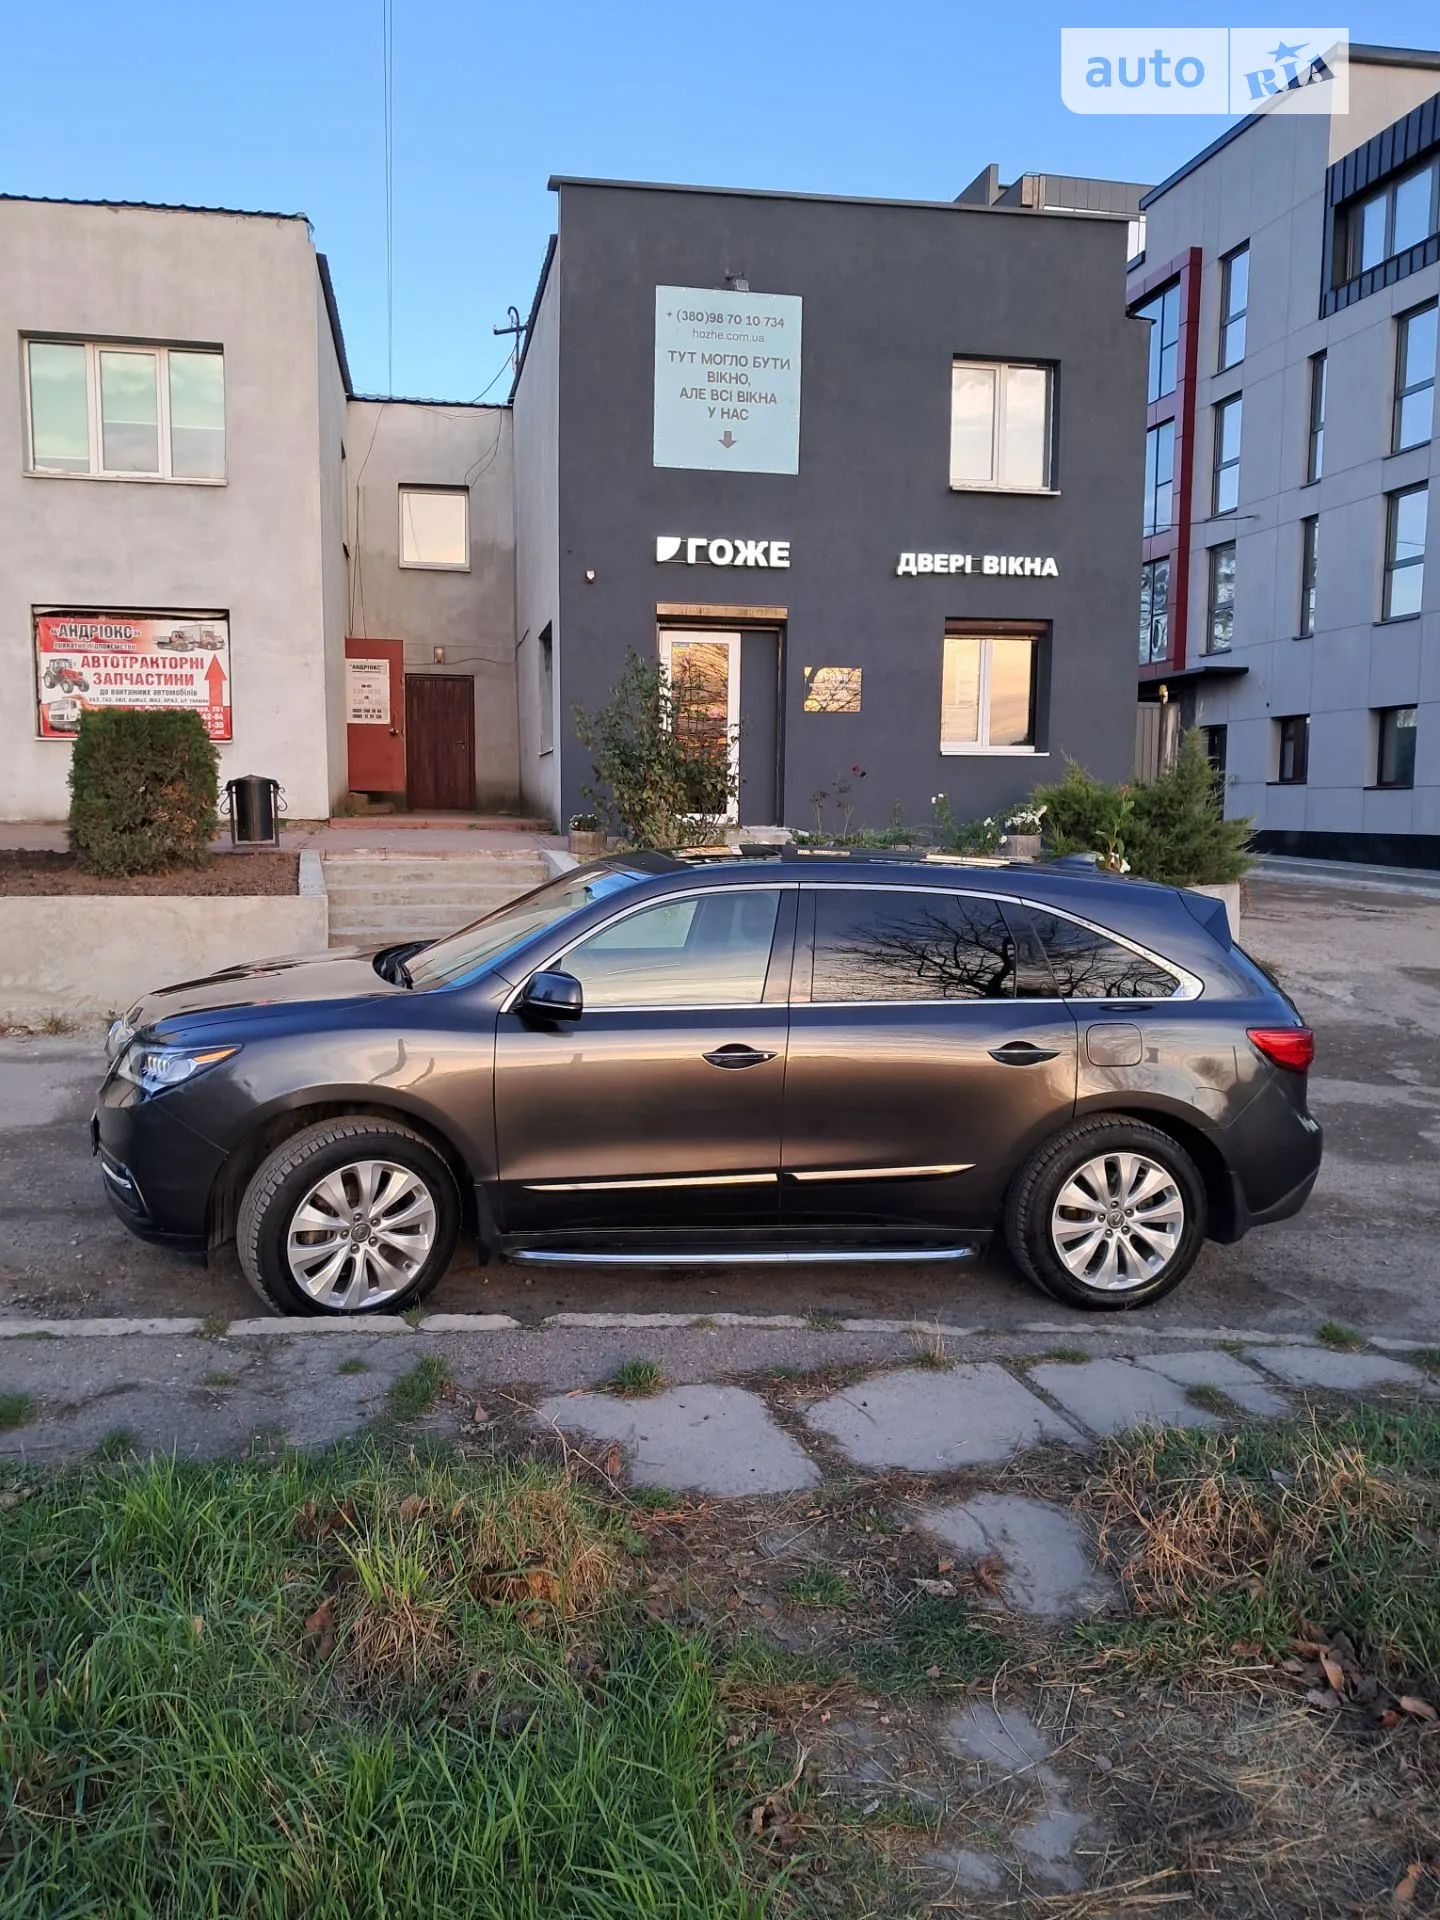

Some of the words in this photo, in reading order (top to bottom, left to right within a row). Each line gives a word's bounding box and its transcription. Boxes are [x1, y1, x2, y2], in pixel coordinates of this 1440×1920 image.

[676, 309, 724, 325] (380)98
[727, 314, 741, 326] 70
[745, 316, 761, 326] 10
[764, 317, 785, 328] 734
[692, 328, 765, 343] hozhe.com.ua
[668, 350, 697, 364] ТУТ
[701, 353, 748, 367] МОГЛО
[753, 357, 791, 370] БУТИ
[707, 371, 751, 386] ВІКНО,
[680, 387, 707, 400] АЛЕ
[711, 389, 733, 402] ВСІ
[737, 391, 777, 404] ВІКНА
[708, 406, 716, 419] У
[720, 408, 749, 421] НАС
[686, 537, 791, 568] ГОЖЕ
[897, 552, 973, 577] ДВЕРІ
[983, 554, 1060, 577] ВІКНА
[51, 624, 140, 640] «АНДРІОКС»
[81, 655, 205, 670] АВТОТРАКТОРНІ
[93, 672, 195, 686] ЗАПЧАСТИНИ
[100, 688, 109, 696] до
[153, 688, 198, 697] автомобілів
